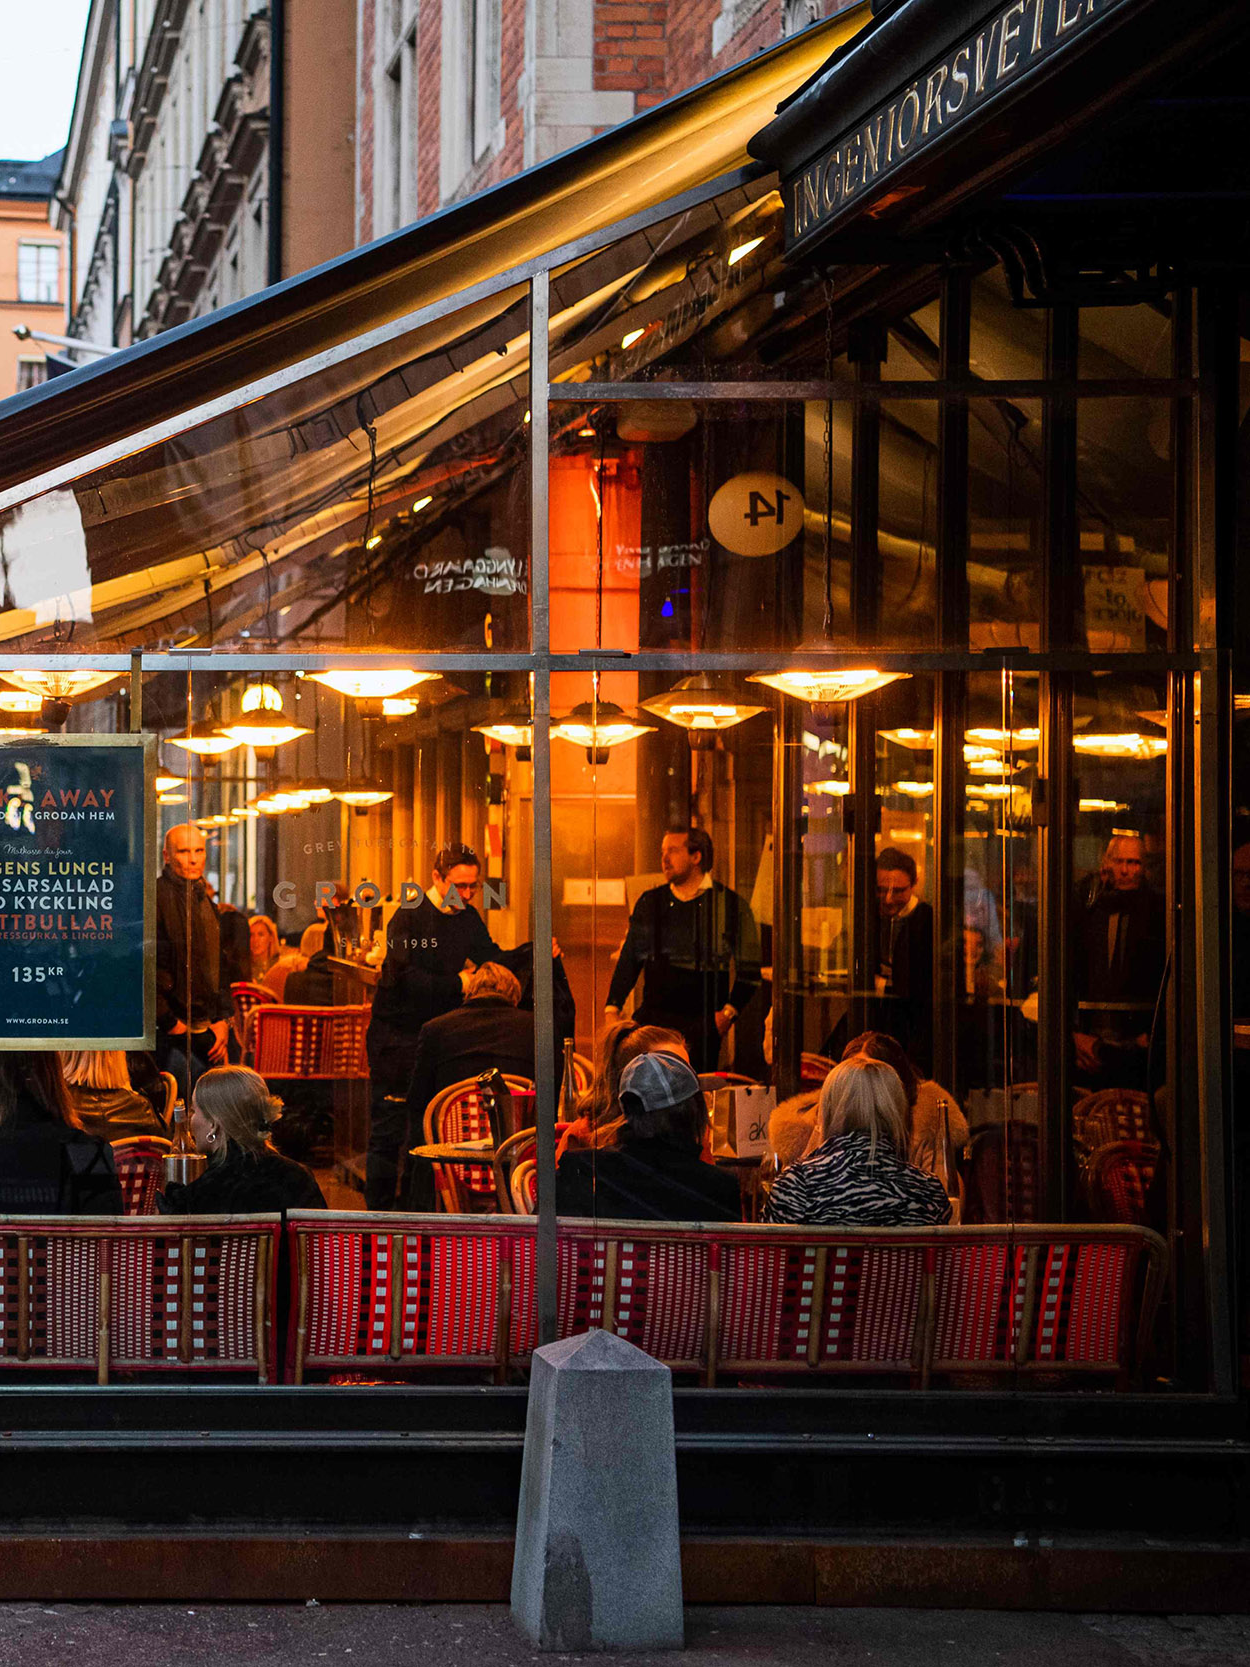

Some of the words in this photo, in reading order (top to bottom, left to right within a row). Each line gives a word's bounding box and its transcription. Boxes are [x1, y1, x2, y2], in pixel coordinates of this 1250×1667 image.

[794, 0, 1095, 238] INGENIÖRSVET
[40, 788, 115, 807] AWAY
[34, 811, 85, 820] GRODAN
[89, 811, 115, 820] HEM
[48, 862, 114, 876] LUNCH
[272, 881, 507, 909] GRODAN
[14, 896, 113, 910] KYCKLING
[61, 932, 68, 940] &
[72, 932, 113, 940] LINGON
[403, 938, 438, 949] 1985
